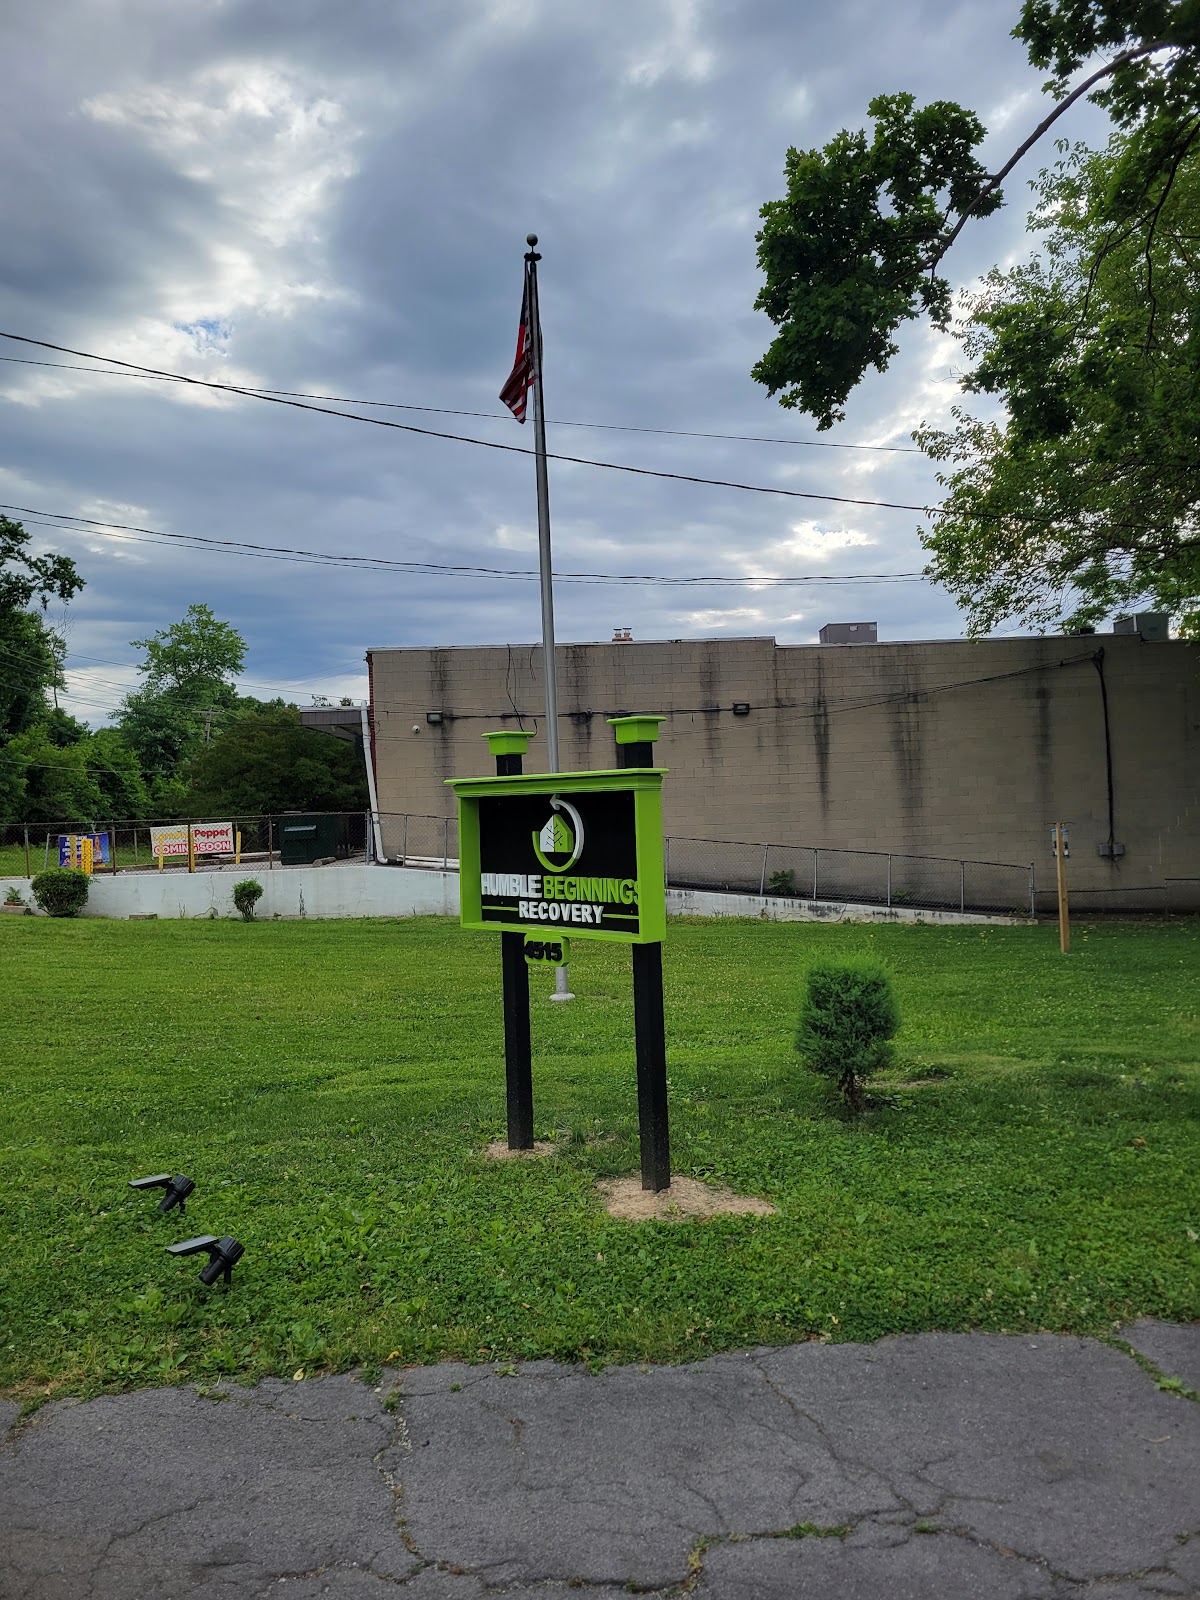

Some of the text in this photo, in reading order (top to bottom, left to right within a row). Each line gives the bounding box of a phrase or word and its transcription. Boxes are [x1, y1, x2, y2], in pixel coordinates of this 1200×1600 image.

[194, 827, 231, 839] Pepper
[199, 840, 232, 852] SOON
[481, 873, 542, 898] HUMBLE
[518, 900, 604, 924] RECOVERY
[524, 940, 563, 962] 4515
